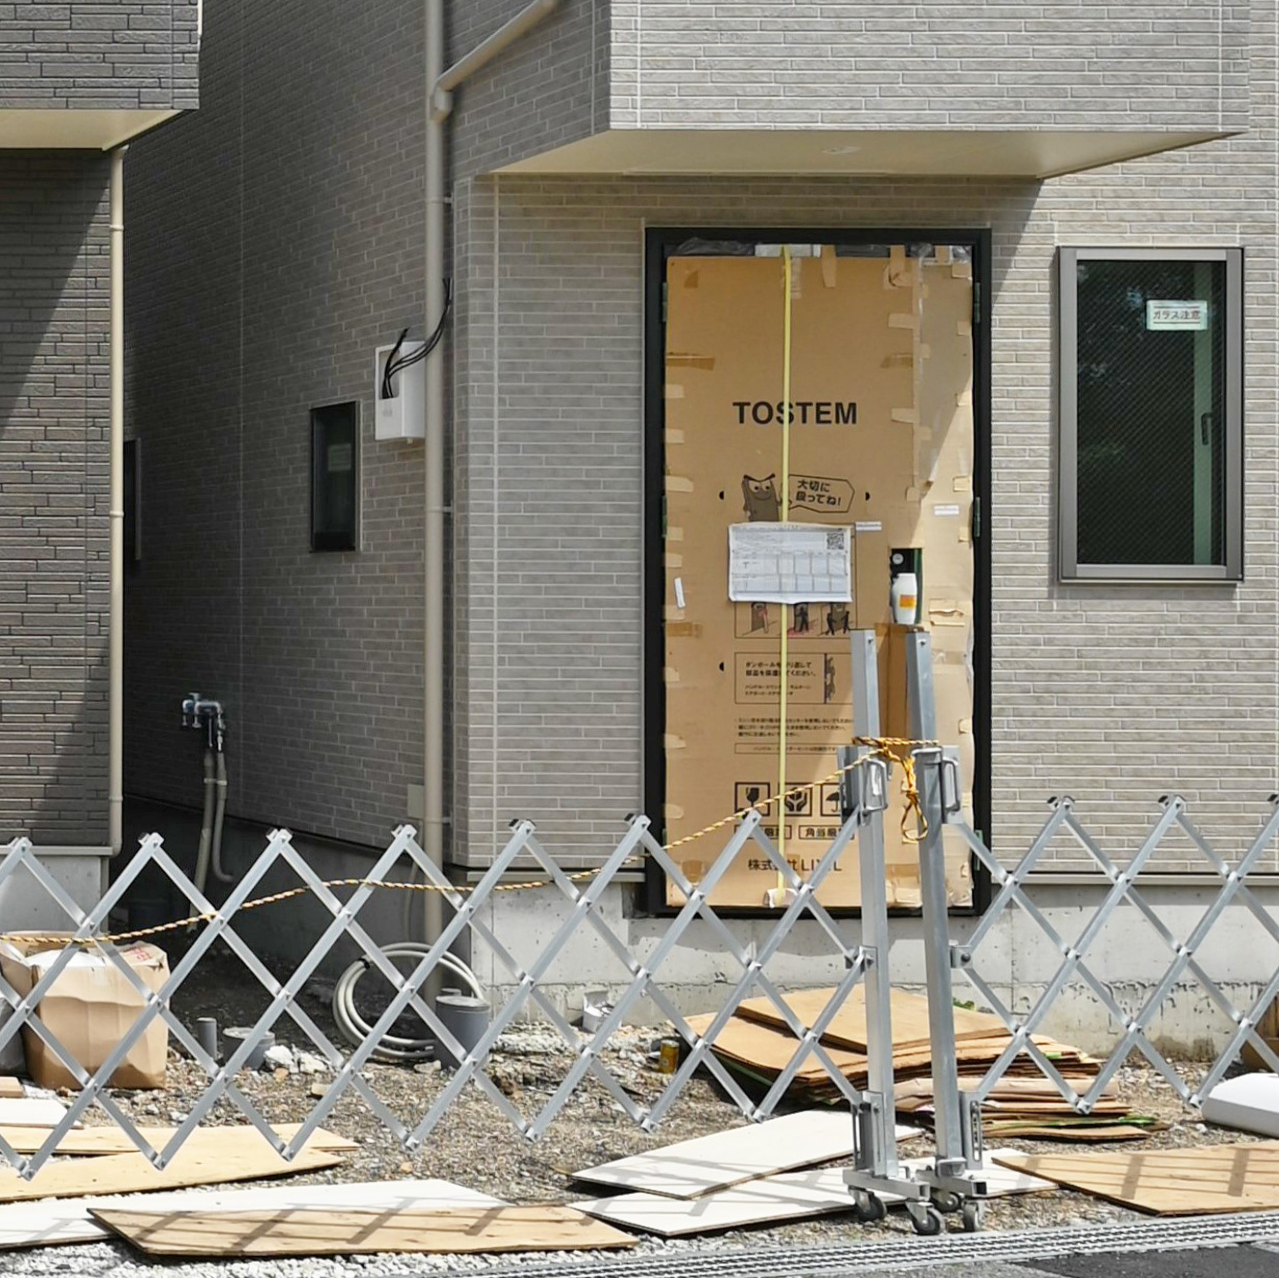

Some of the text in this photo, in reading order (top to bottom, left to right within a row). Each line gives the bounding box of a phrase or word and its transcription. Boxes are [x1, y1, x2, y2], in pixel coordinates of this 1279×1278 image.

[1153, 310, 1201, 320] ガラス注意
[732, 401, 857, 425] TOSTEM
[797, 479, 831, 493] 大切に
[747, 859, 842, 871] 株式社 LIL
